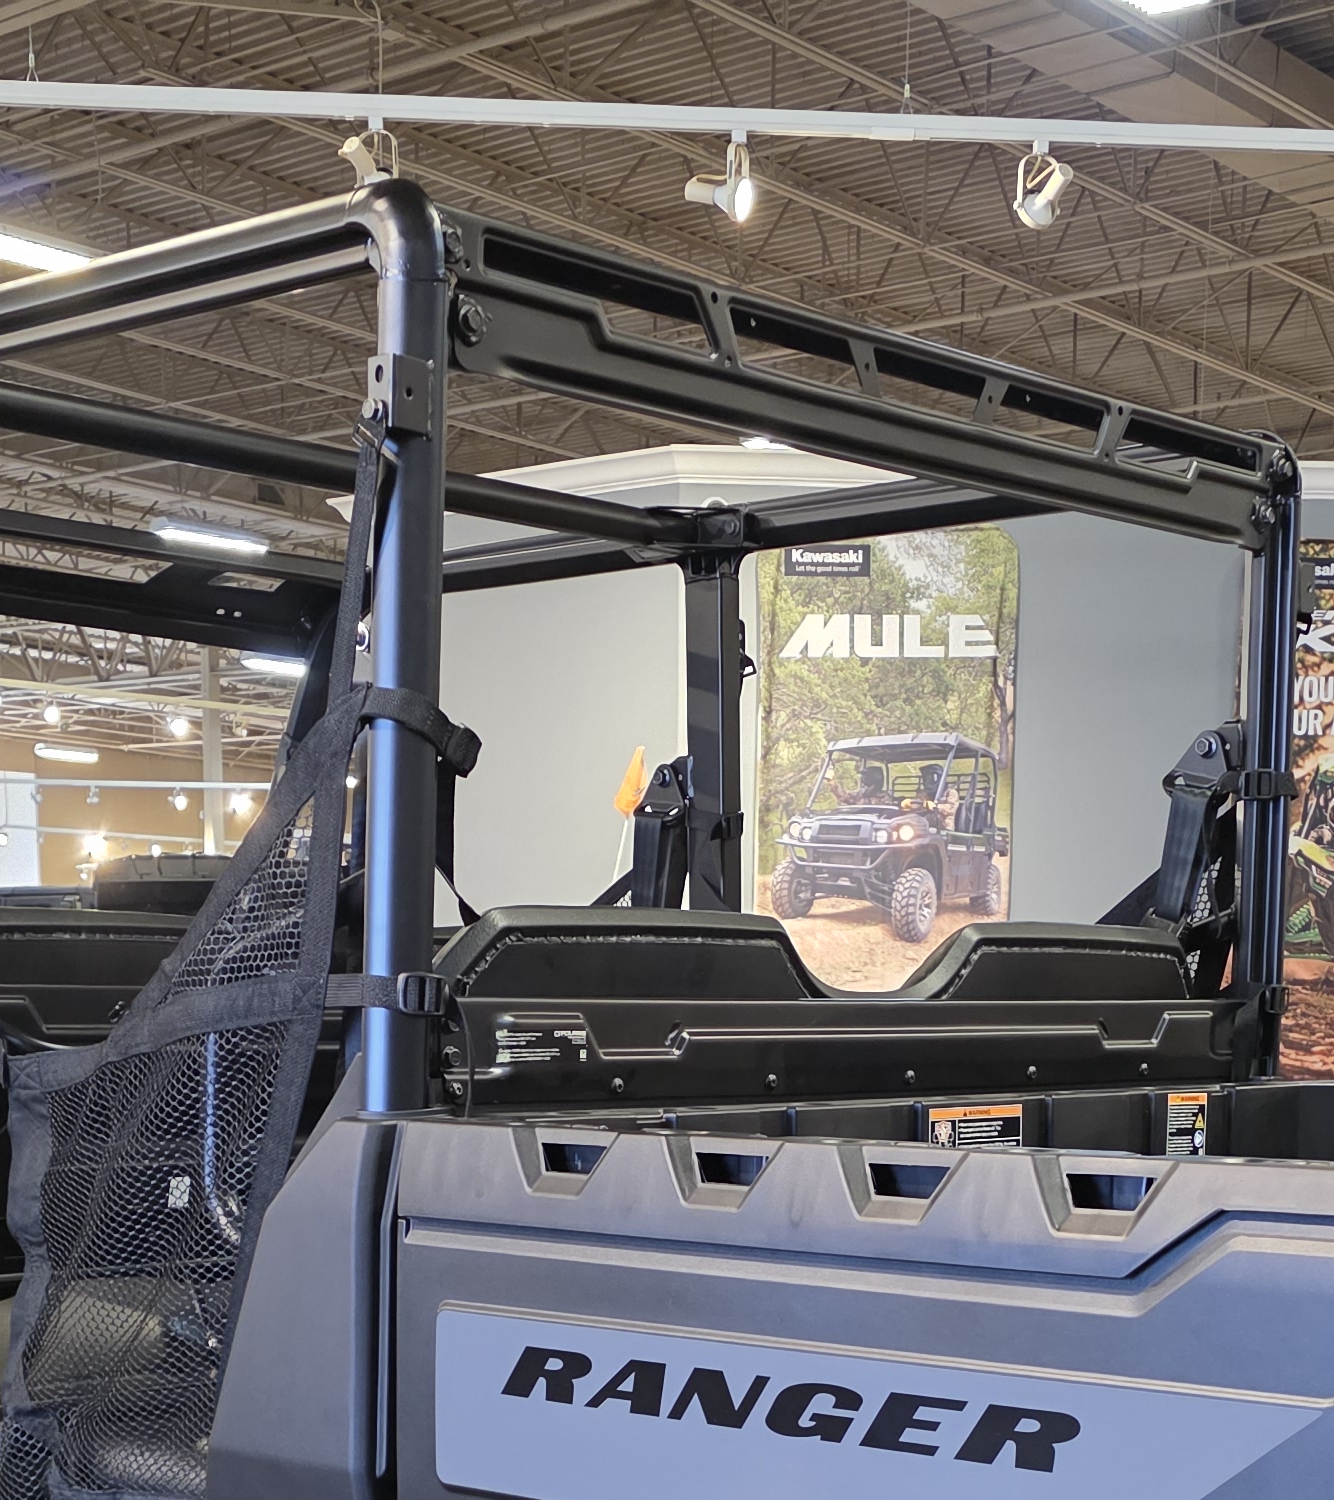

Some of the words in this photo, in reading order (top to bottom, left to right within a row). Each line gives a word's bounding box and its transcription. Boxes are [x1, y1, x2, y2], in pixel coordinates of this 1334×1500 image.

[791, 549, 863, 564] Kawasaki
[779, 613, 999, 658] MULE
[1293, 709, 1324, 736] UR
[500, 1345, 1082, 1473] RANGER
